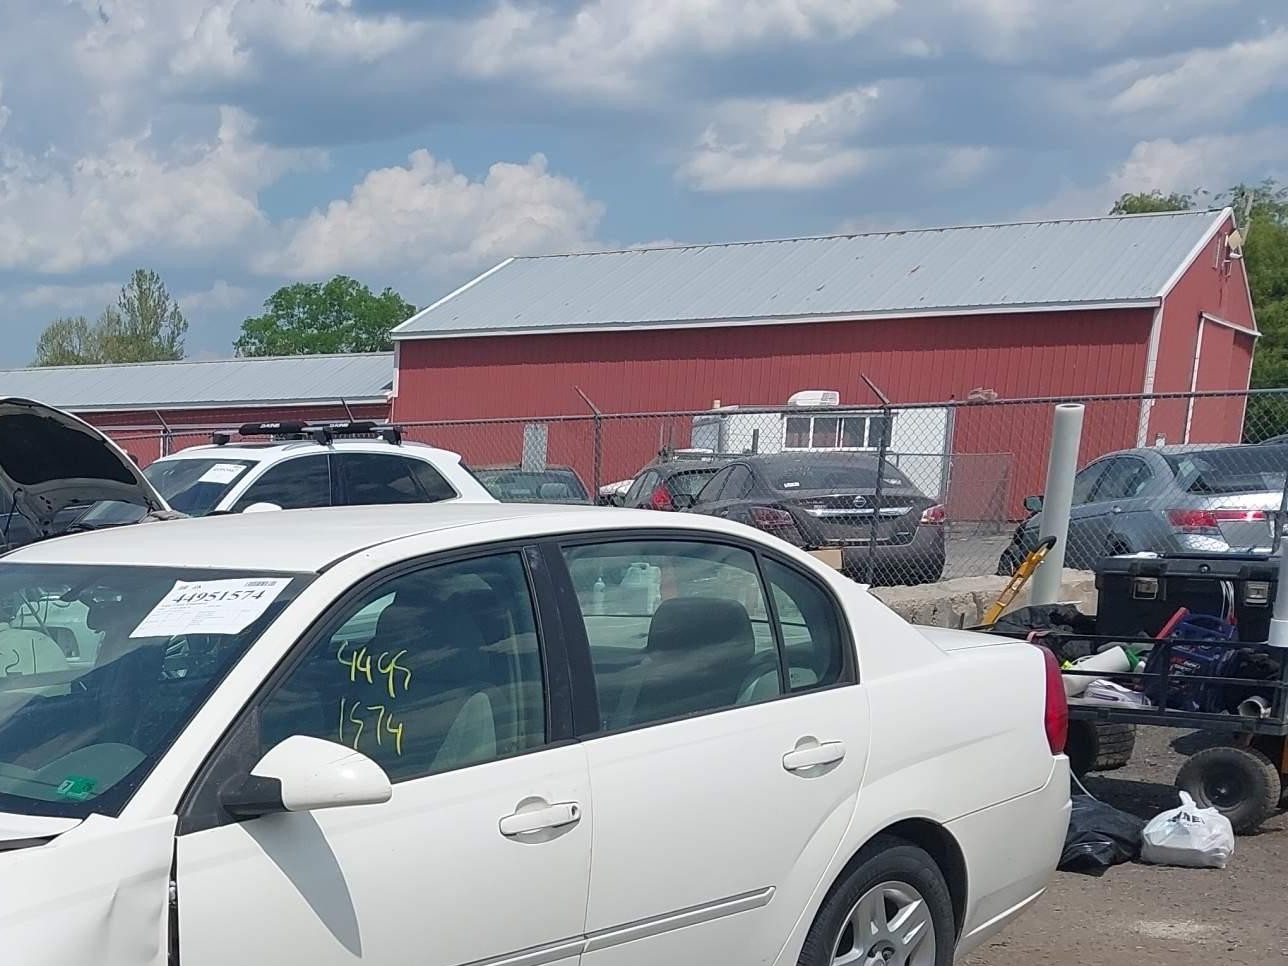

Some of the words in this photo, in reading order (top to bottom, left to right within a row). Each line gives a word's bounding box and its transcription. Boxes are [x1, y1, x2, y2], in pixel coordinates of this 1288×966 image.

[173, 590, 266, 604] 44951574
[337, 640, 412, 698] 4495
[339, 698, 403, 756] 1574
